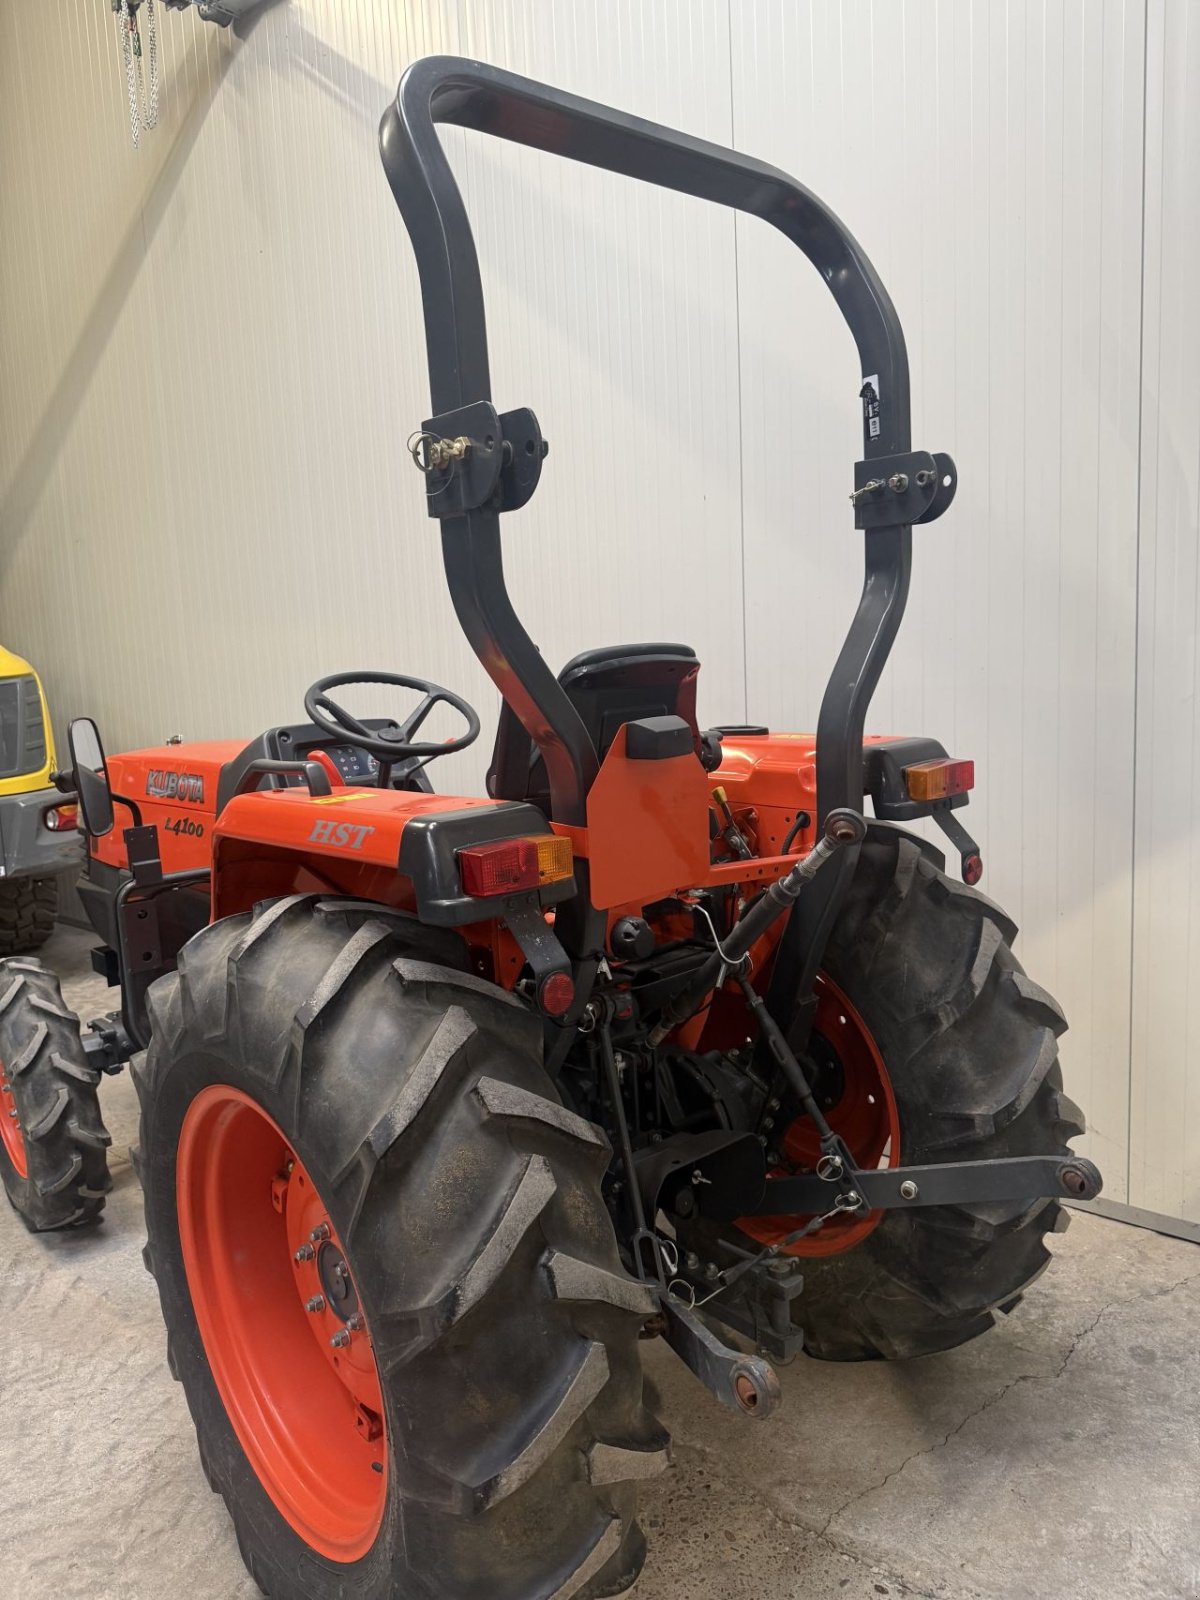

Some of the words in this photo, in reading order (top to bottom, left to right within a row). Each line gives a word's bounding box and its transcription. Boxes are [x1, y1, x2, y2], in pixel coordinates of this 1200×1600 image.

[146, 769, 205, 804] KUBOTA
[164, 817, 204, 837] L4100
[307, 819, 376, 849] HST
